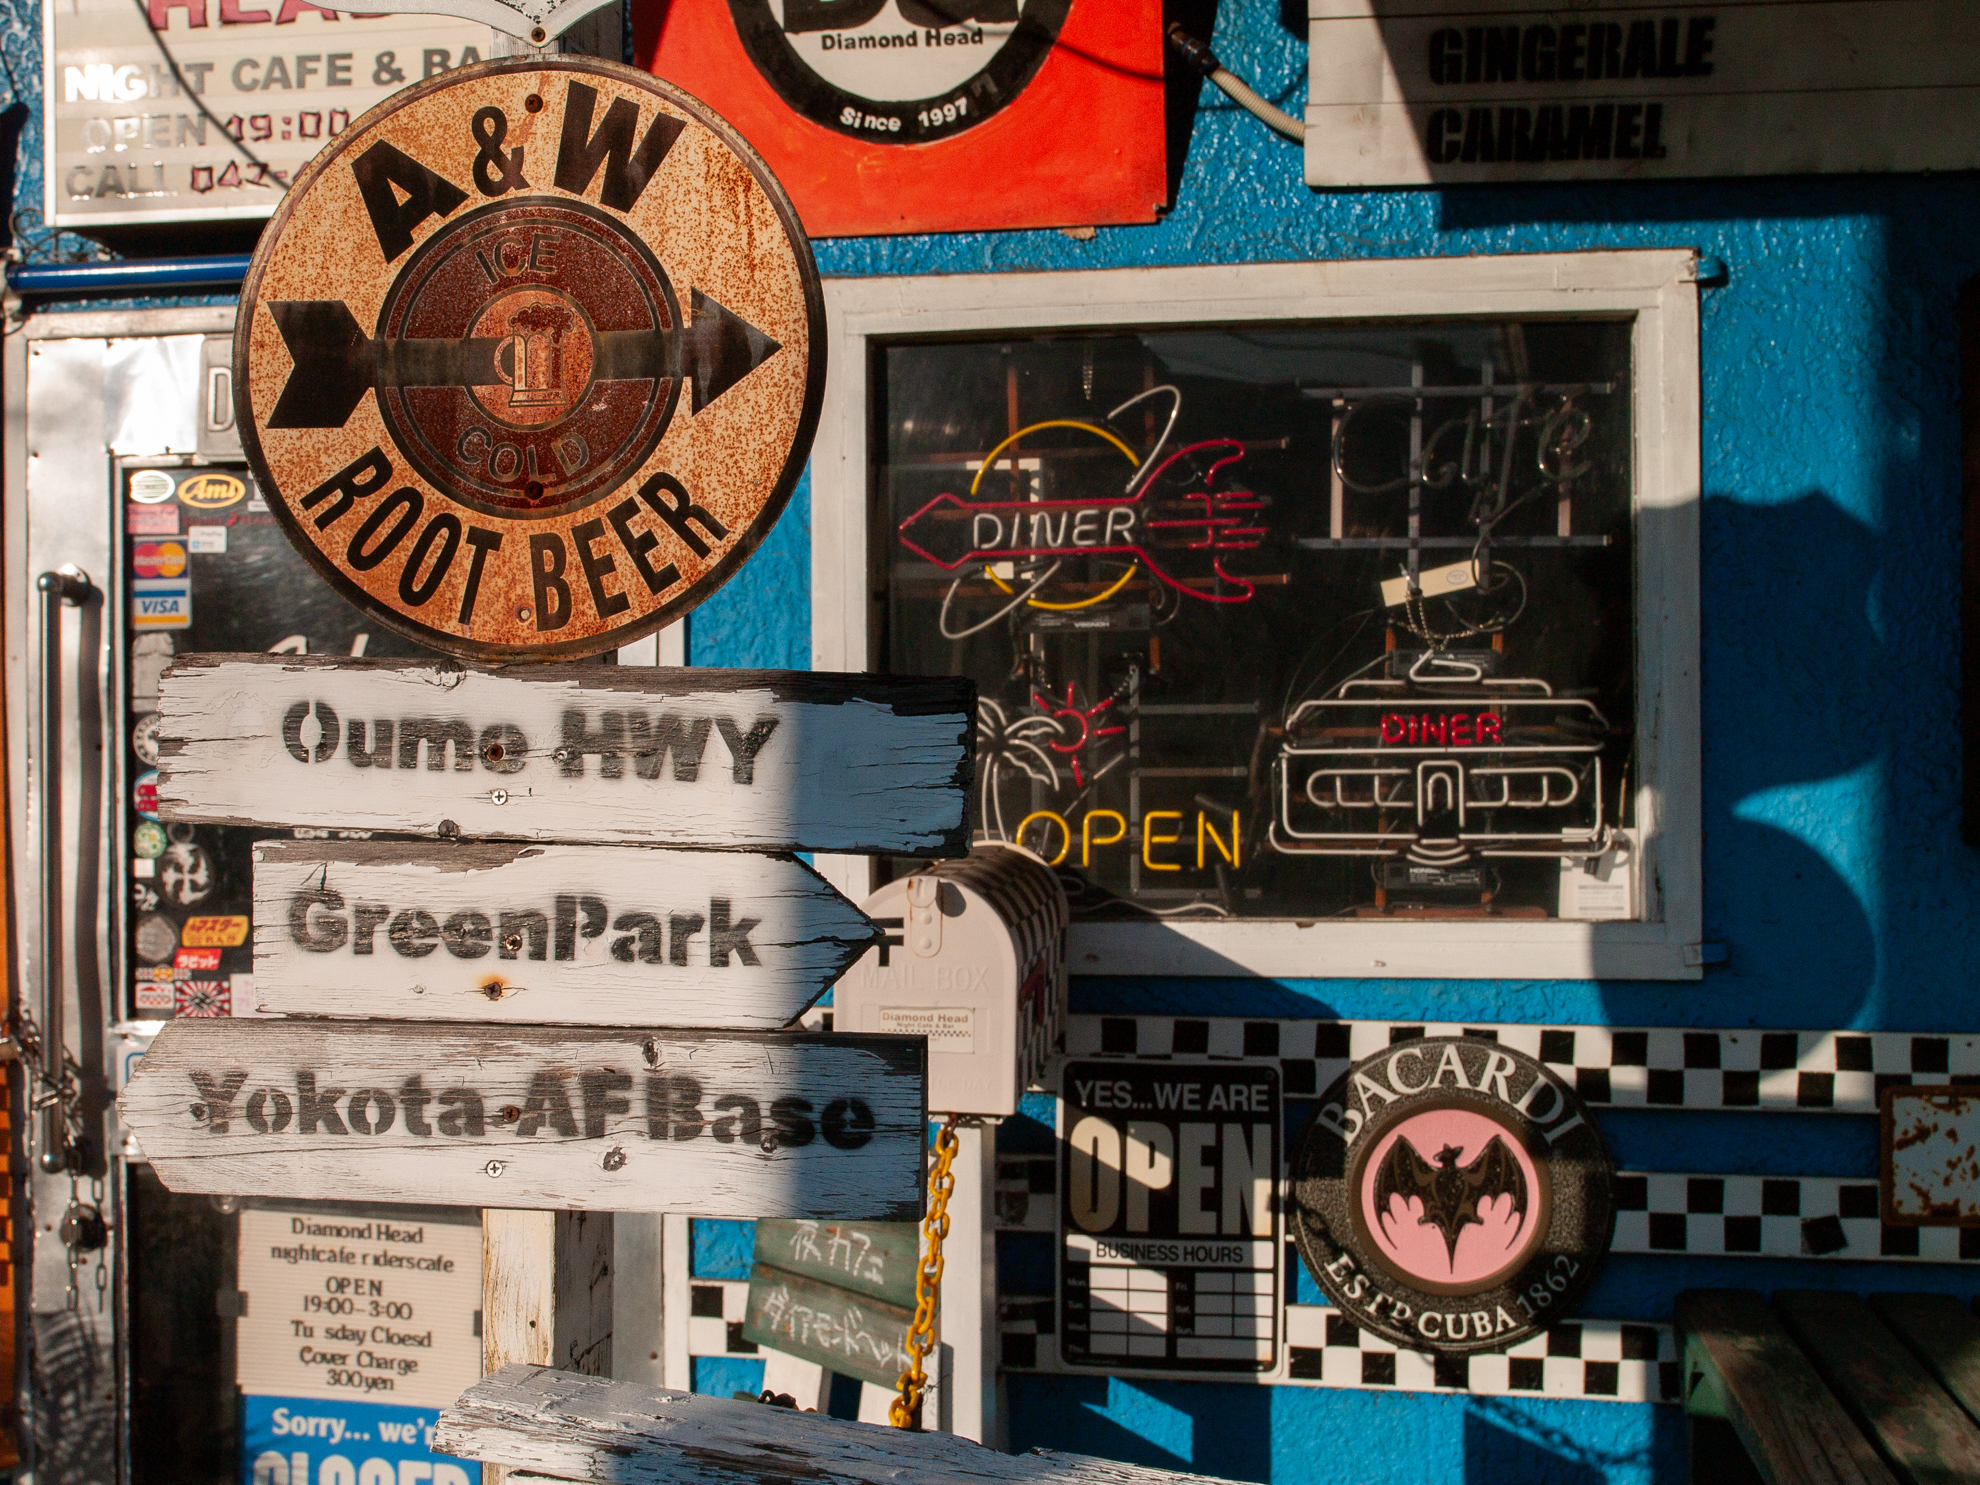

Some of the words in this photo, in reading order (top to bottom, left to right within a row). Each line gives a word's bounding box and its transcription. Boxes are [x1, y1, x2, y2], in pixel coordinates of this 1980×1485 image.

[821, 29, 918, 51] Diamond
[925, 27, 983, 48] Head
[1429, 16, 1716, 84] GINGERALE
[64, 62, 214, 102] NIGHT
[231, 53, 353, 91] CAFE
[372, 51, 405, 86] &
[422, 47, 486, 78] BA
[80, 110, 206, 152] OPEN
[840, 107, 901, 132] Since
[918, 97, 968, 128] 1997
[1426, 103, 1667, 163] CARAMEL
[65, 161, 178, 201] CALL
[190, 160, 312, 195] 042-
[475, 232, 561, 285] ICE
[456, 425, 590, 483] COLD
[299, 446, 503, 625] ROOT
[530, 471, 730, 632] BEER
[973, 507, 1135, 550] DINER
[141, 599, 179, 614] VISA
[282, 700, 527, 774] Oume
[558, 710, 780, 785] HWY
[1381, 712, 1501, 745] DINER
[1016, 809, 1240, 871] OPEN
[177, 954, 219, 968] ラビット
[863, 963, 923, 990] MAIL
[937, 966, 989, 991] BOX
[882, 1012, 933, 1022] Diamond
[938, 1013, 968, 1023] Head
[188, 1070, 485, 1138] Yokota
[1207, 1084, 1269, 1111] ARE
[1317, 1042, 1585, 1147] BACARDI
[1069, 1115, 1273, 1237] OPEN
[291, 1217, 372, 1239] Diamond
[376, 1223, 423, 1243] Head
[1095, 1240, 1178, 1262] BUSINESS
[1184, 1246, 1243, 1264] HOURS
[325, 1276, 383, 1296] OPEN
[1418, 1304, 1518, 1339] CUBA
[1516, 1255, 1579, 1318] 1862
[371, 1327, 432, 1348] Cloesd
[299, 1346, 349, 1366] Cover
[357, 1351, 418, 1376] Charge
[272, 1407, 370, 1445] Sorry...
[378, 1417, 436, 1446] we'r
